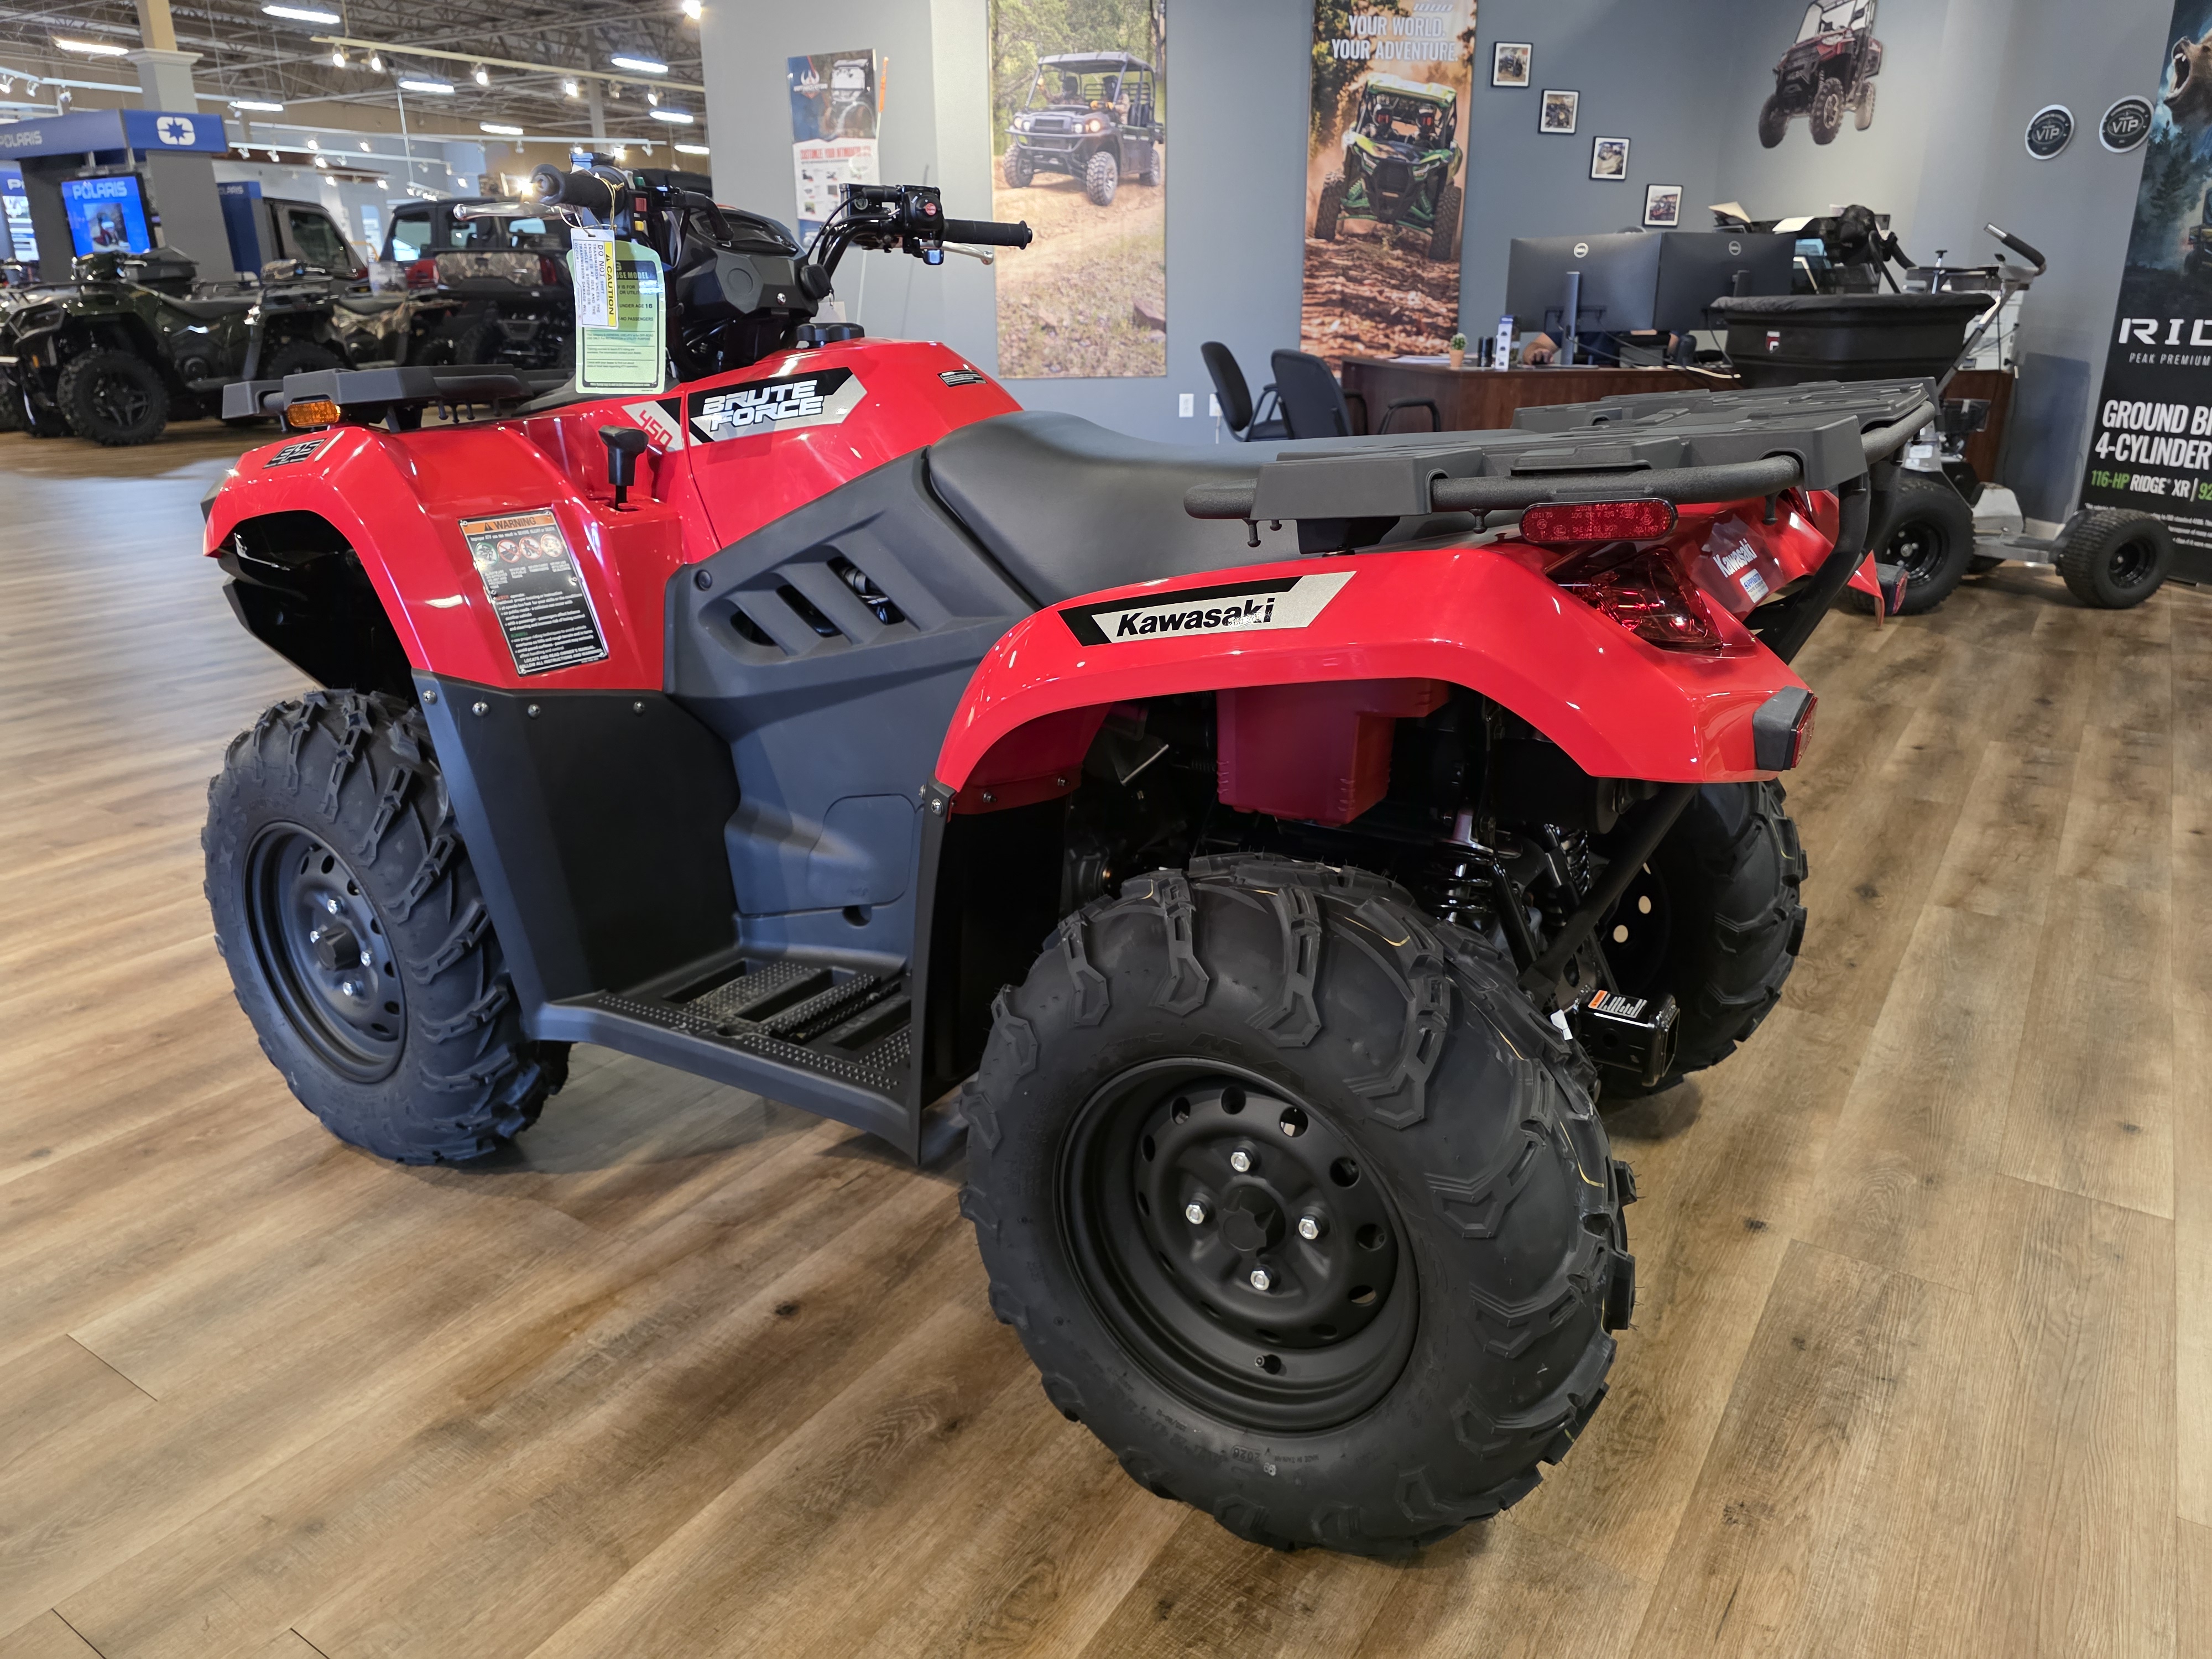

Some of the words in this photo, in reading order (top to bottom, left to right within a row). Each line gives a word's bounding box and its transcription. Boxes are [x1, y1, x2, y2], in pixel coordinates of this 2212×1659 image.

[1348, 15, 1387, 36] YOUR
[1392, 17, 1446, 37] WORLD.
[1331, 39, 1371, 60] YOUR
[1375, 41, 1458, 61] ADVENTURE.
[2036, 128, 2059, 140] VIP
[2112, 119, 2138, 133] VIP
[72, 181, 128, 200] POLARIS
[598, 245, 604, 257] DO
[2129, 352, 2156, 364] PEAK
[2160, 353, 2211, 366] PREMIUM
[702, 379, 817, 415] BRUTE
[710, 395, 824, 431] FORCE
[2102, 399, 2189, 434] GROUND
[639, 410, 674, 446] 450
[2095, 431, 2212, 470] 4-CYLINDER
[2091, 470, 2130, 490] 116-HP
[2171, 479, 2191, 498] XR
[493, 517, 537, 530] WARNING
[1713, 538, 1757, 578] Kawasaki
[1116, 597, 1275, 637] Kawasaki
